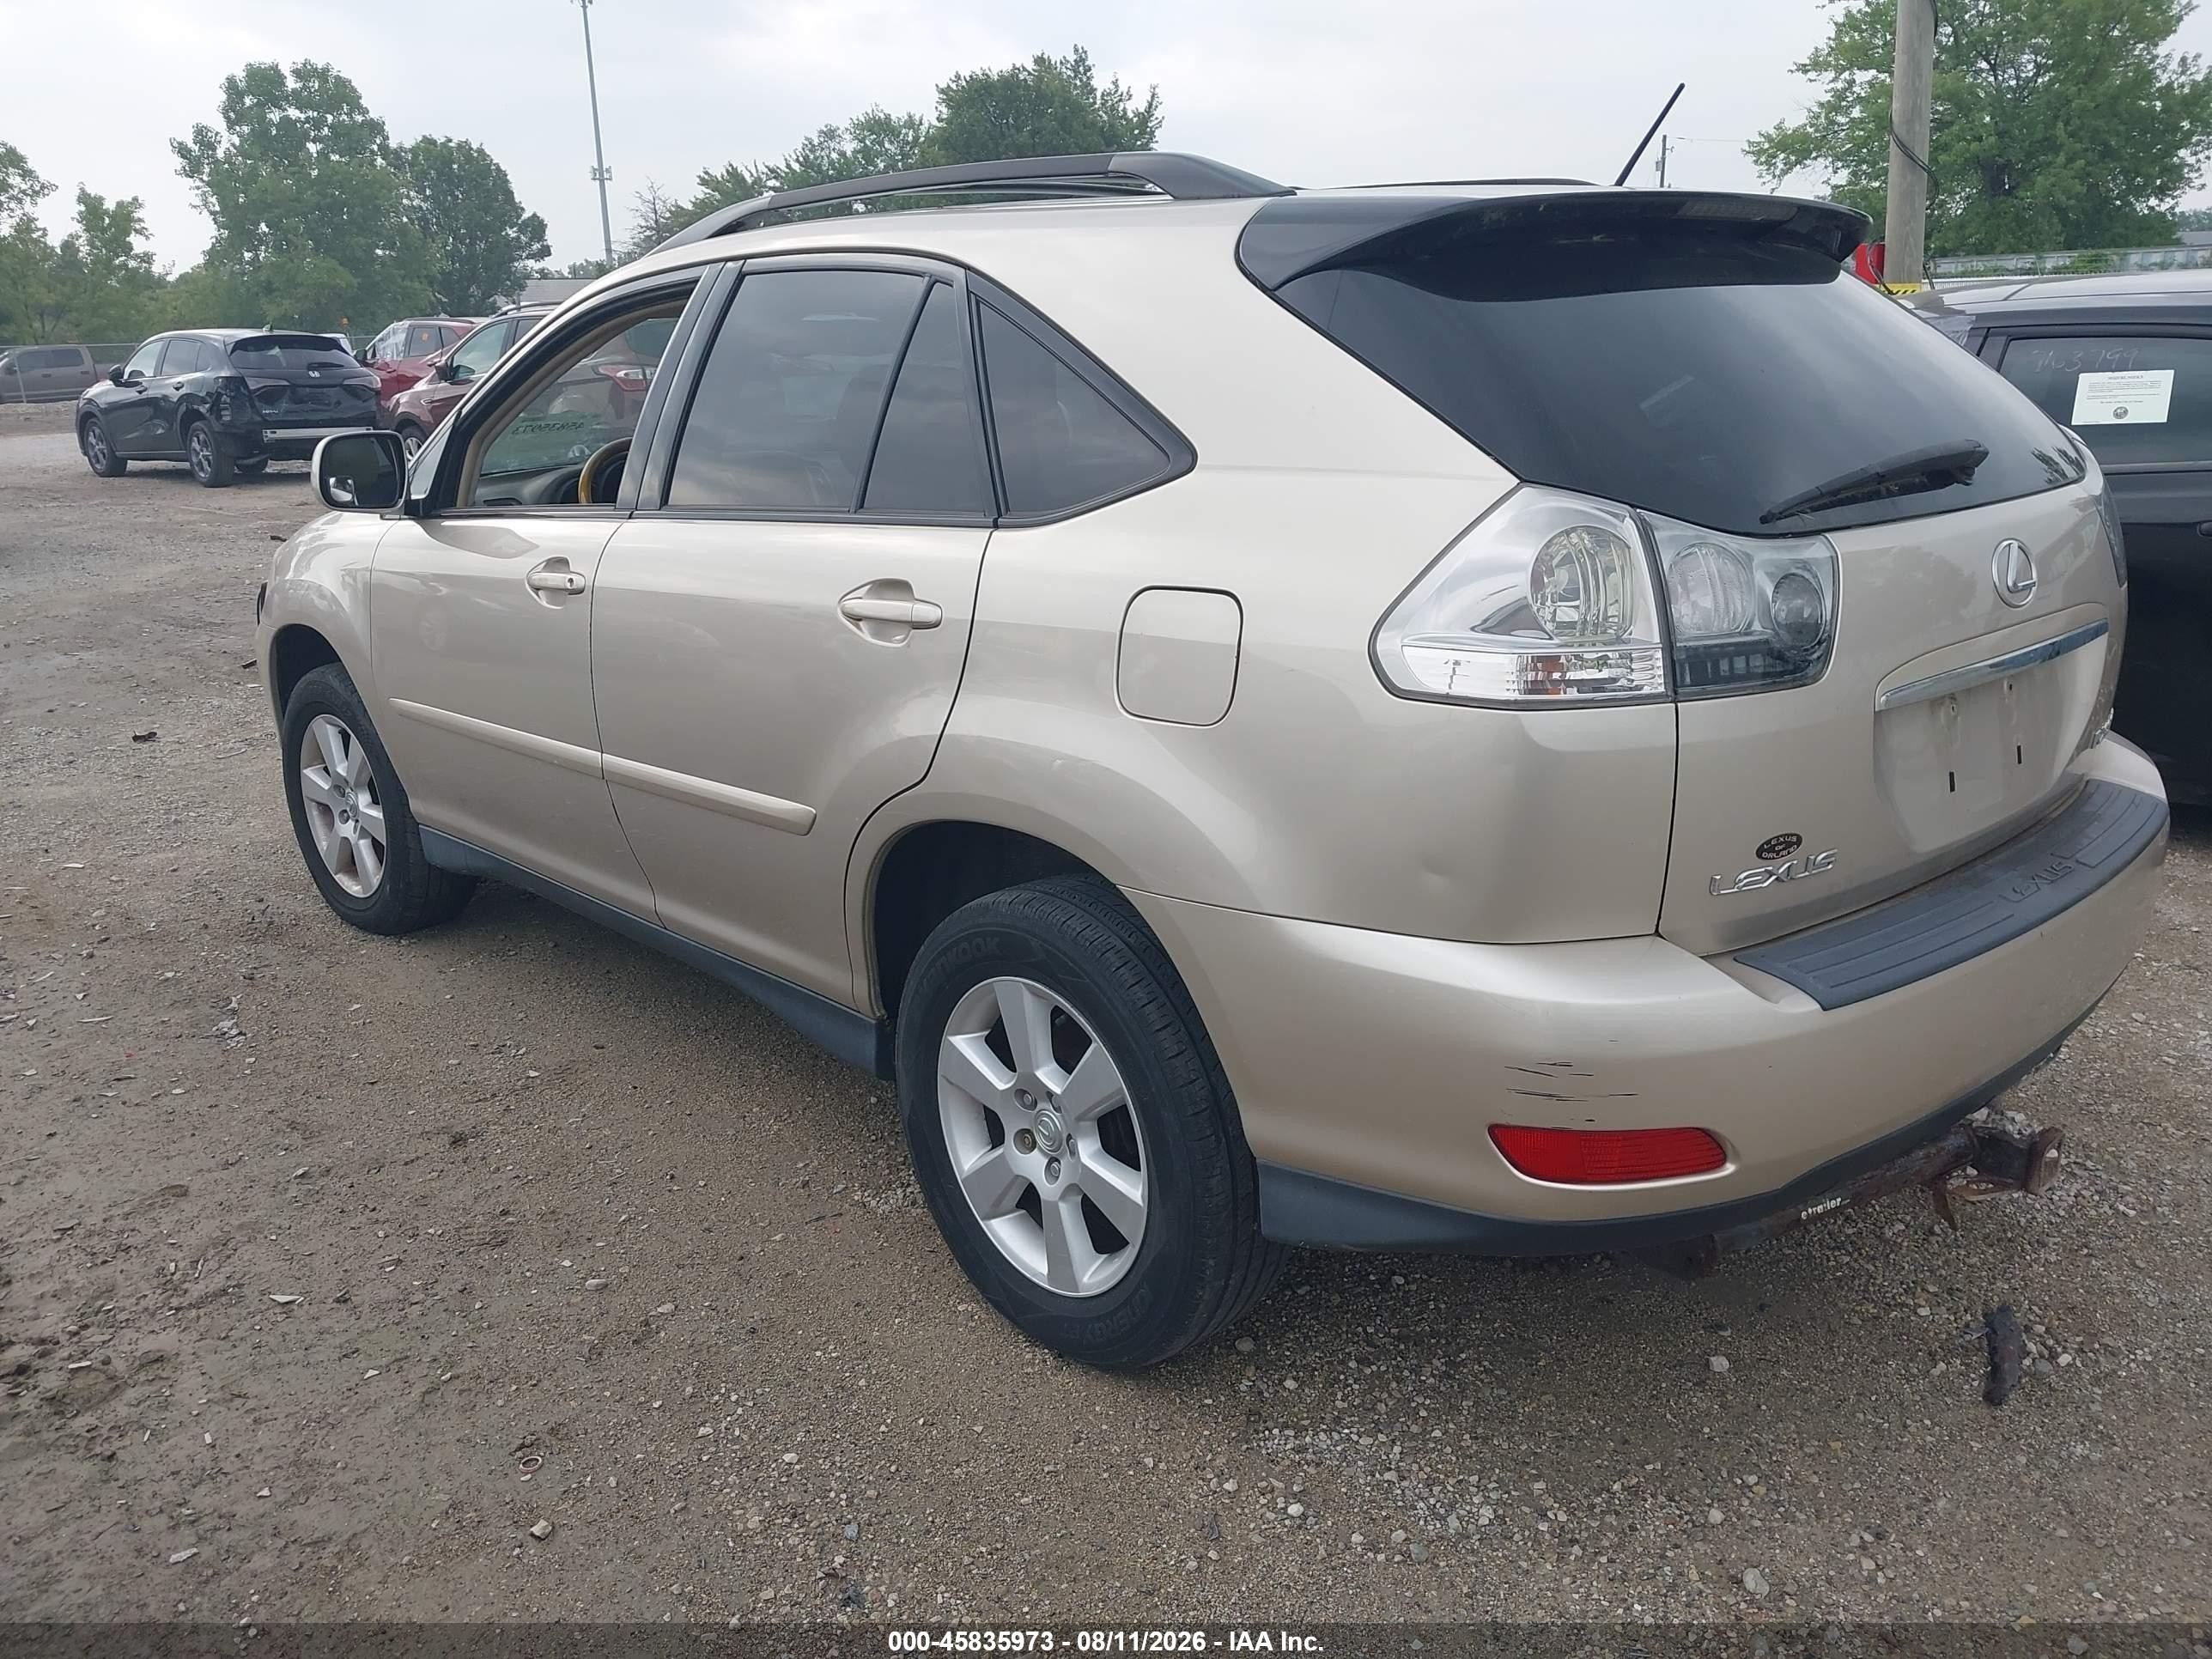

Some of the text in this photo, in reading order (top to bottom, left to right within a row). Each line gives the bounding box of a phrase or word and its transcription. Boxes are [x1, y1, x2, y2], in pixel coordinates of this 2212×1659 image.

[1761, 844, 1797, 859] ORLAND
[1763, 836, 1798, 849] LEXUS
[1710, 848, 1838, 896] LEXUS
[1998, 861, 2075, 903] LEXUS
